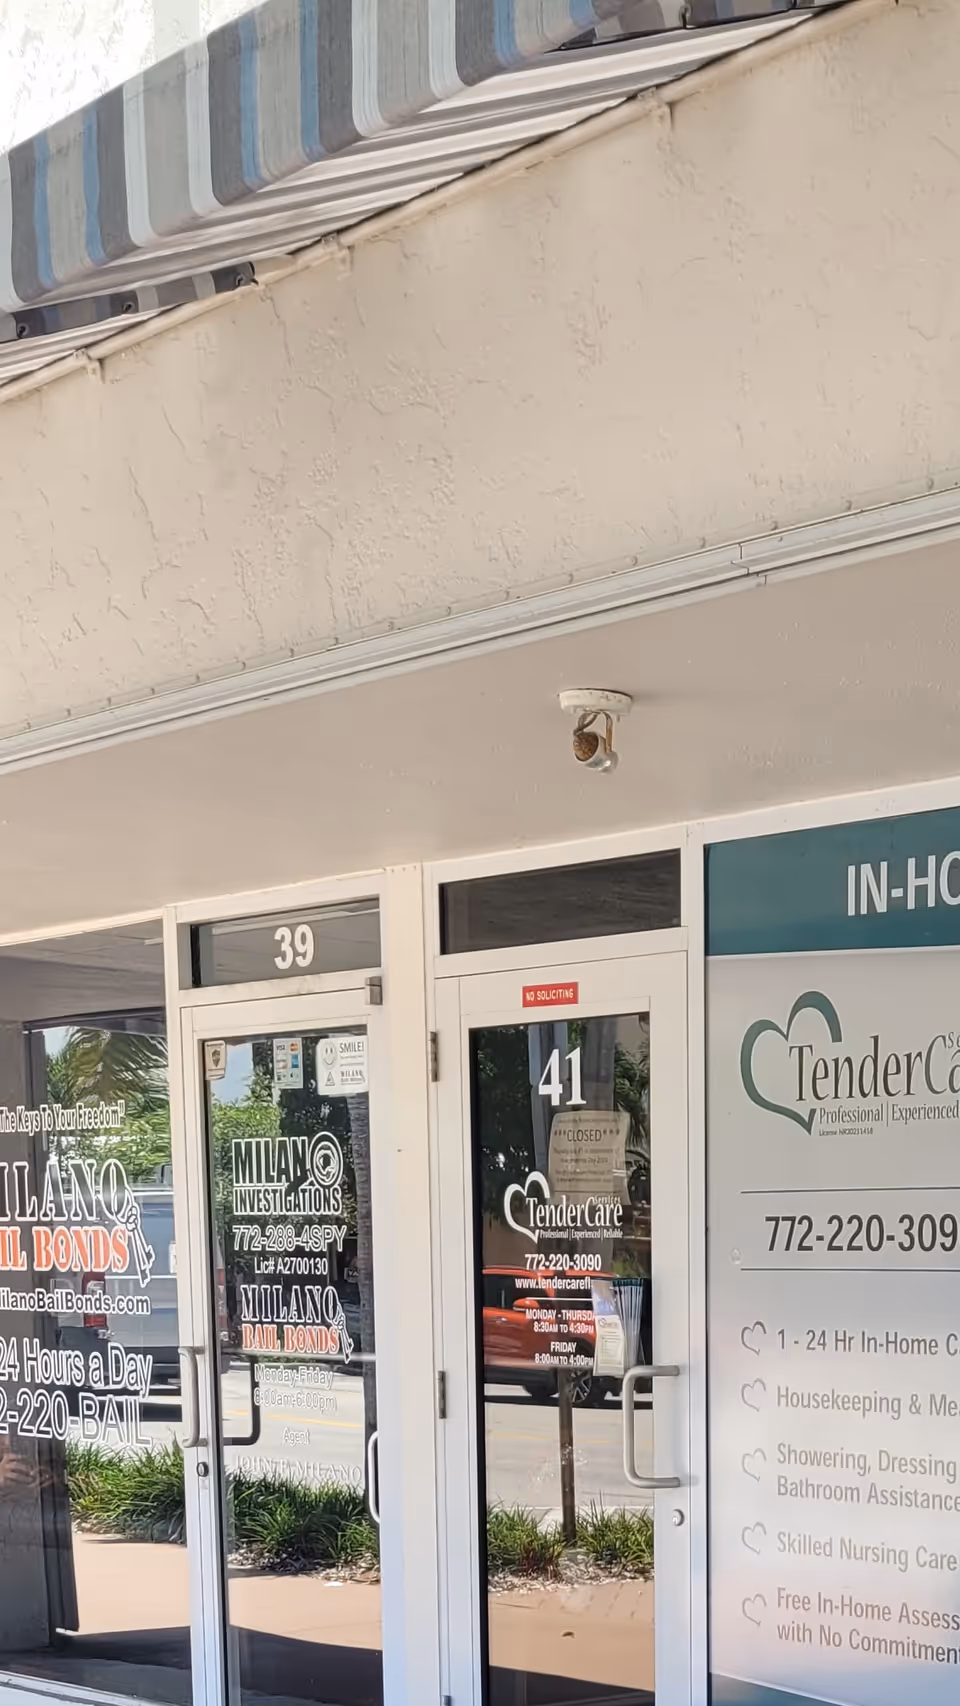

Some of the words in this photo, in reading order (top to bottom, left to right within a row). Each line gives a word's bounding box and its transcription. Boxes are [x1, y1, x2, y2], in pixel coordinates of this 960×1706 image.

[274, 924, 314, 969] 39
[526, 991, 535, 1001] NO
[537, 988, 573, 1001] SOLICITING
[538, 1046, 587, 1106] 41
[16, 1105, 40, 1137] Keys
[40, 1104, 53, 1131] To
[53, 1103, 76, 1131] Your
[819, 1103, 884, 1125] Professional
[891, 1100, 960, 1125] Experienced
[232, 1131, 344, 1188] MILANO
[233, 1186, 342, 1215] INVESTIGATIONS
[526, 1195, 623, 1227] TenderCare
[232, 1225, 348, 1252] 772-288-4SPY
[540, 1229, 569, 1239] Professional
[571, 1229, 600, 1240] Experienced
[603, 1228, 623, 1239] Reliable
[32, 1226, 129, 1272] BONDS
[524, 1254, 602, 1271] 772-220-3090
[254, 1256, 275, 1275] Lic#
[276, 1257, 329, 1276] A2700130
[241, 1284, 340, 1324] MILANO
[526, 1309, 556, 1320] MONDAY
[242, 1323, 280, 1352] BAIL
[284, 1325, 340, 1354] BONDS
[533, 1321, 558, 1333] 8:30AM
[560, 1324, 568, 1333] TO
[569, 1322, 594, 1334] 4:30PM
[550, 1342, 577, 1353] FRIDAY
[777, 1329, 785, 1350] 1
[806, 1329, 827, 1351] 24
[834, 1330, 855, 1352] Hr
[861, 1330, 939, 1356] In-Home
[23, 1337, 85, 1387] Hours
[89, 1352, 104, 1388] a
[108, 1342, 153, 1400] Day
[535, 1353, 559, 1364] 8:00AM
[560, 1356, 567, 1365] TO
[569, 1354, 594, 1366] 4:00PM
[254, 1364, 334, 1390] Monday-Friday
[777, 1385, 902, 1421] Housekeeping
[909, 1393, 922, 1415] &
[283, 1427, 310, 1446] Agent
[236, 1456, 272, 1474] JOHN
[295, 1461, 362, 1482] MILANO
[777, 1442, 871, 1477] Showering,
[878, 1449, 957, 1484] Dressing
[777, 1475, 860, 1503] Bathroom
[777, 1531, 833, 1558] Skilled
[840, 1536, 908, 1573] Nursing
[915, 1545, 958, 1571] Care
[777, 1587, 811, 1611] Free
[818, 1591, 892, 1622] In-Home
[777, 1621, 812, 1644] with
[819, 1624, 842, 1648] No
